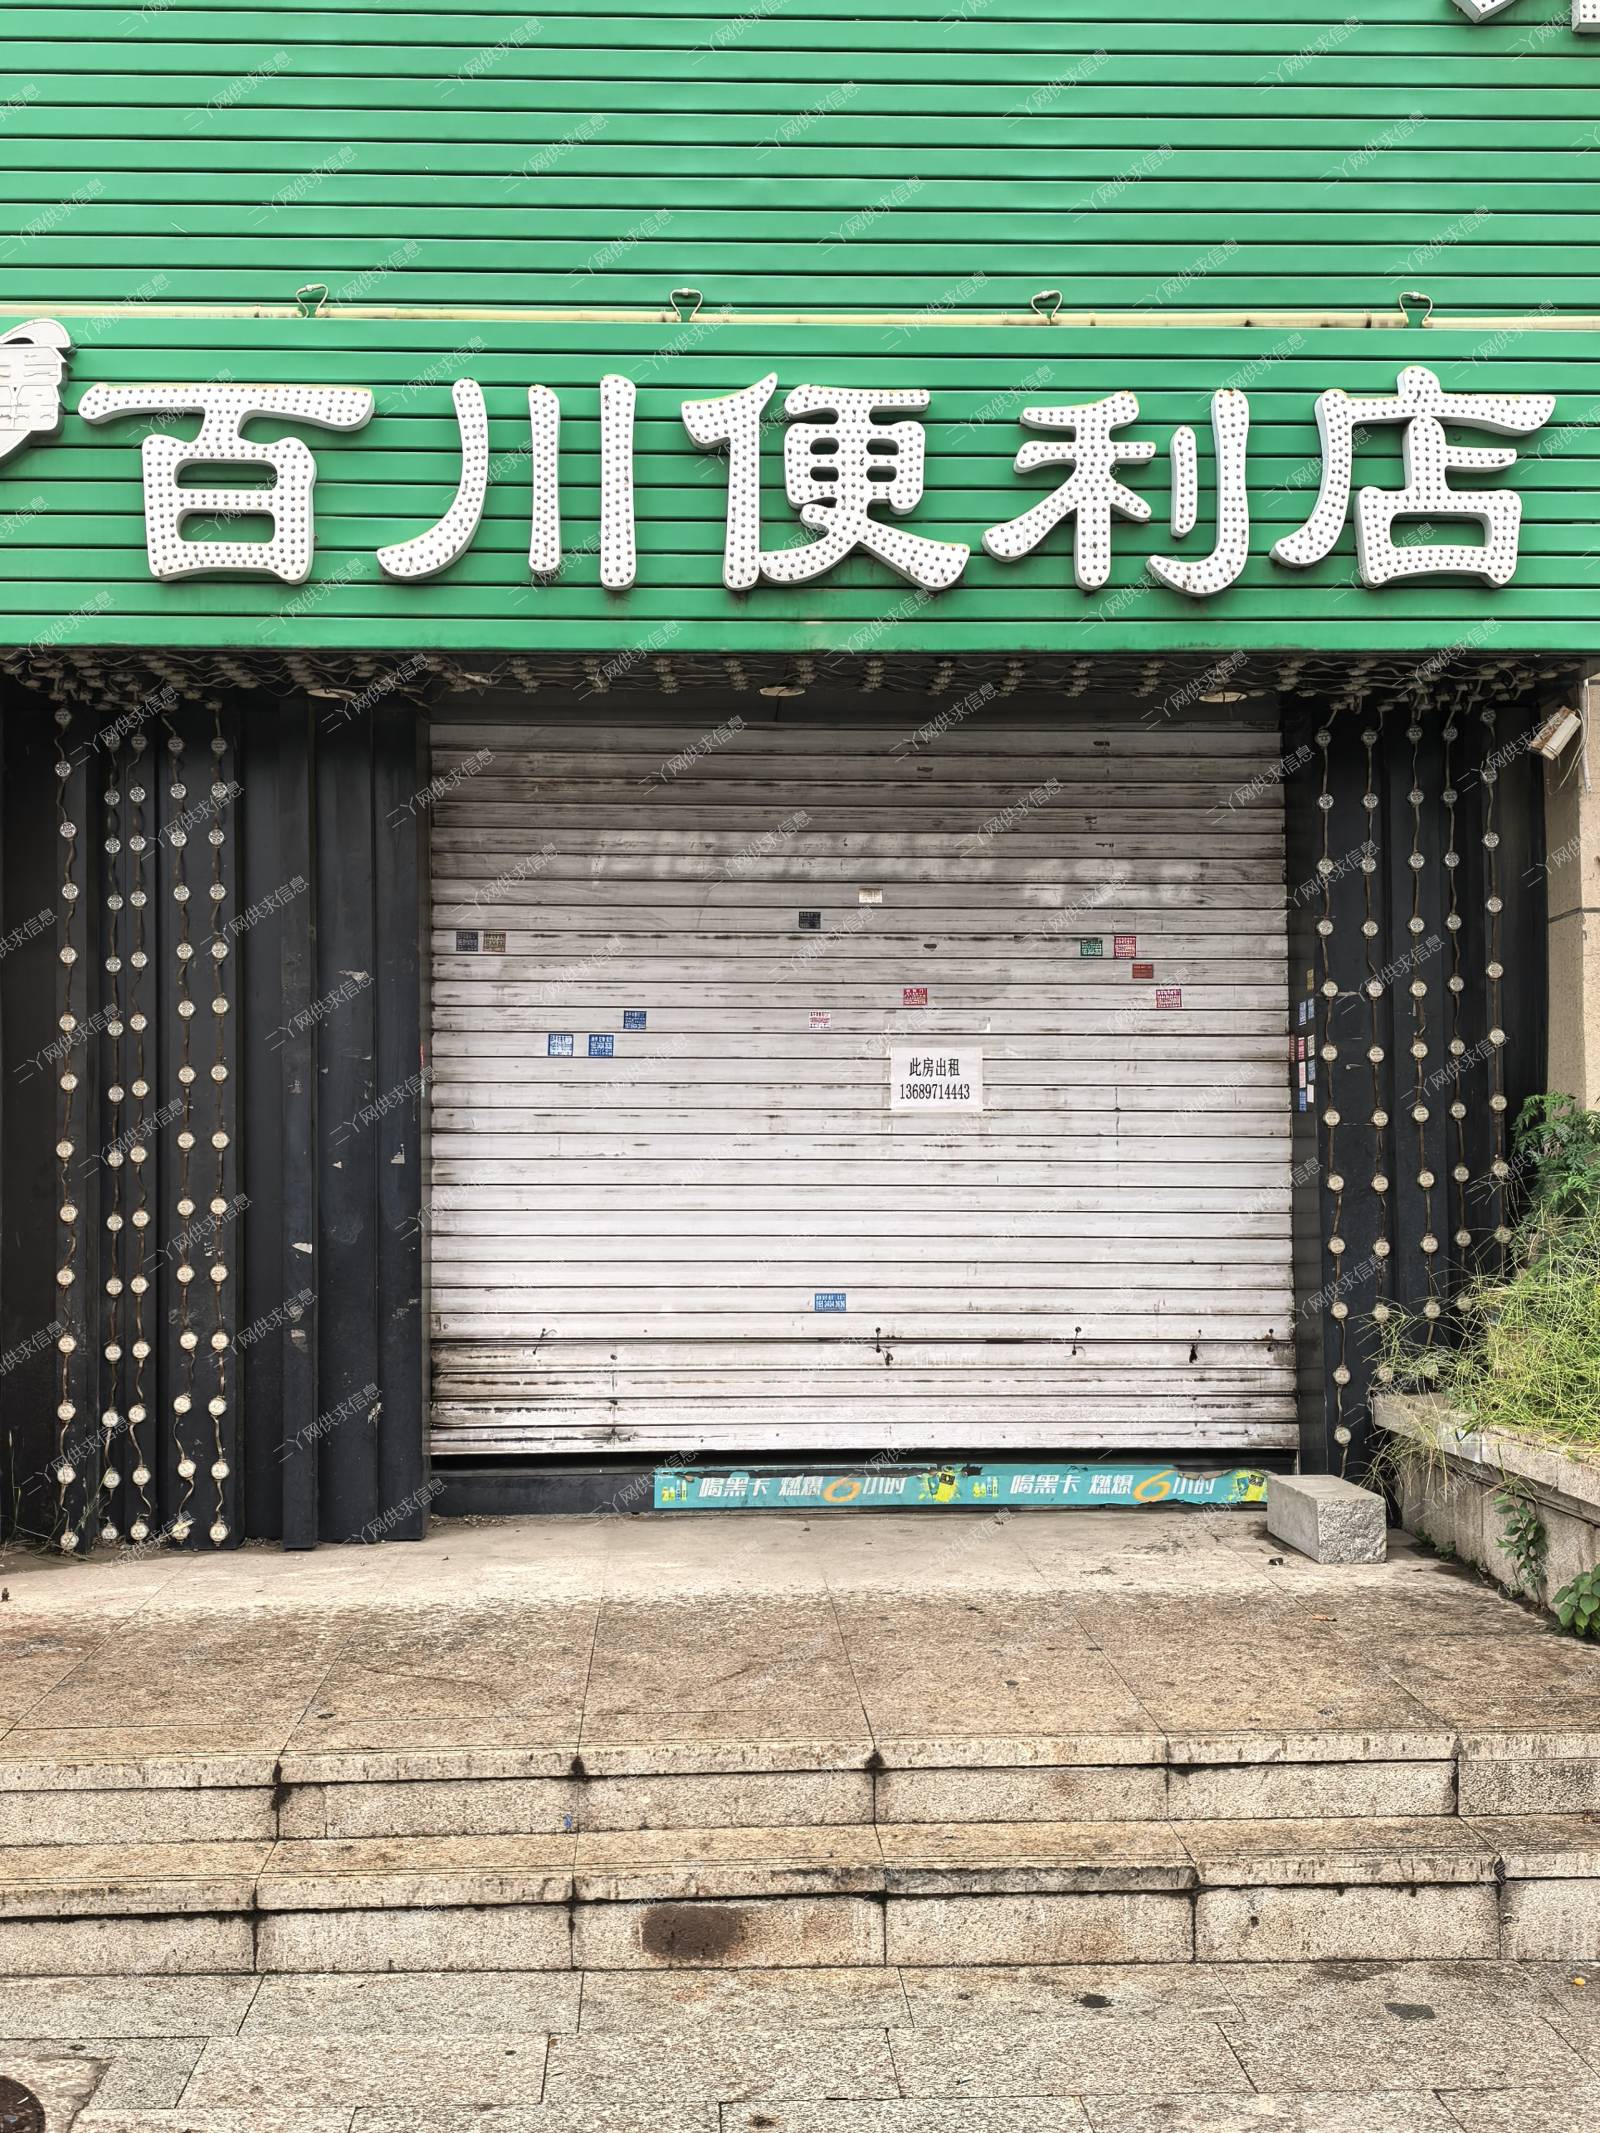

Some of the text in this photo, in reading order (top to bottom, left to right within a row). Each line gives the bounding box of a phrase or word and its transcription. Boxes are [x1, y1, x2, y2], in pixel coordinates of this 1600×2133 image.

[78, 366, 1556, 597] 百川便利店
[909, 1057, 960, 1077] 此房出租
[900, 1083, 970, 1100] 13689714443
[699, 1477, 771, 1498] 喝黑卡
[1010, 1474, 1081, 1494] 喝黑卡
